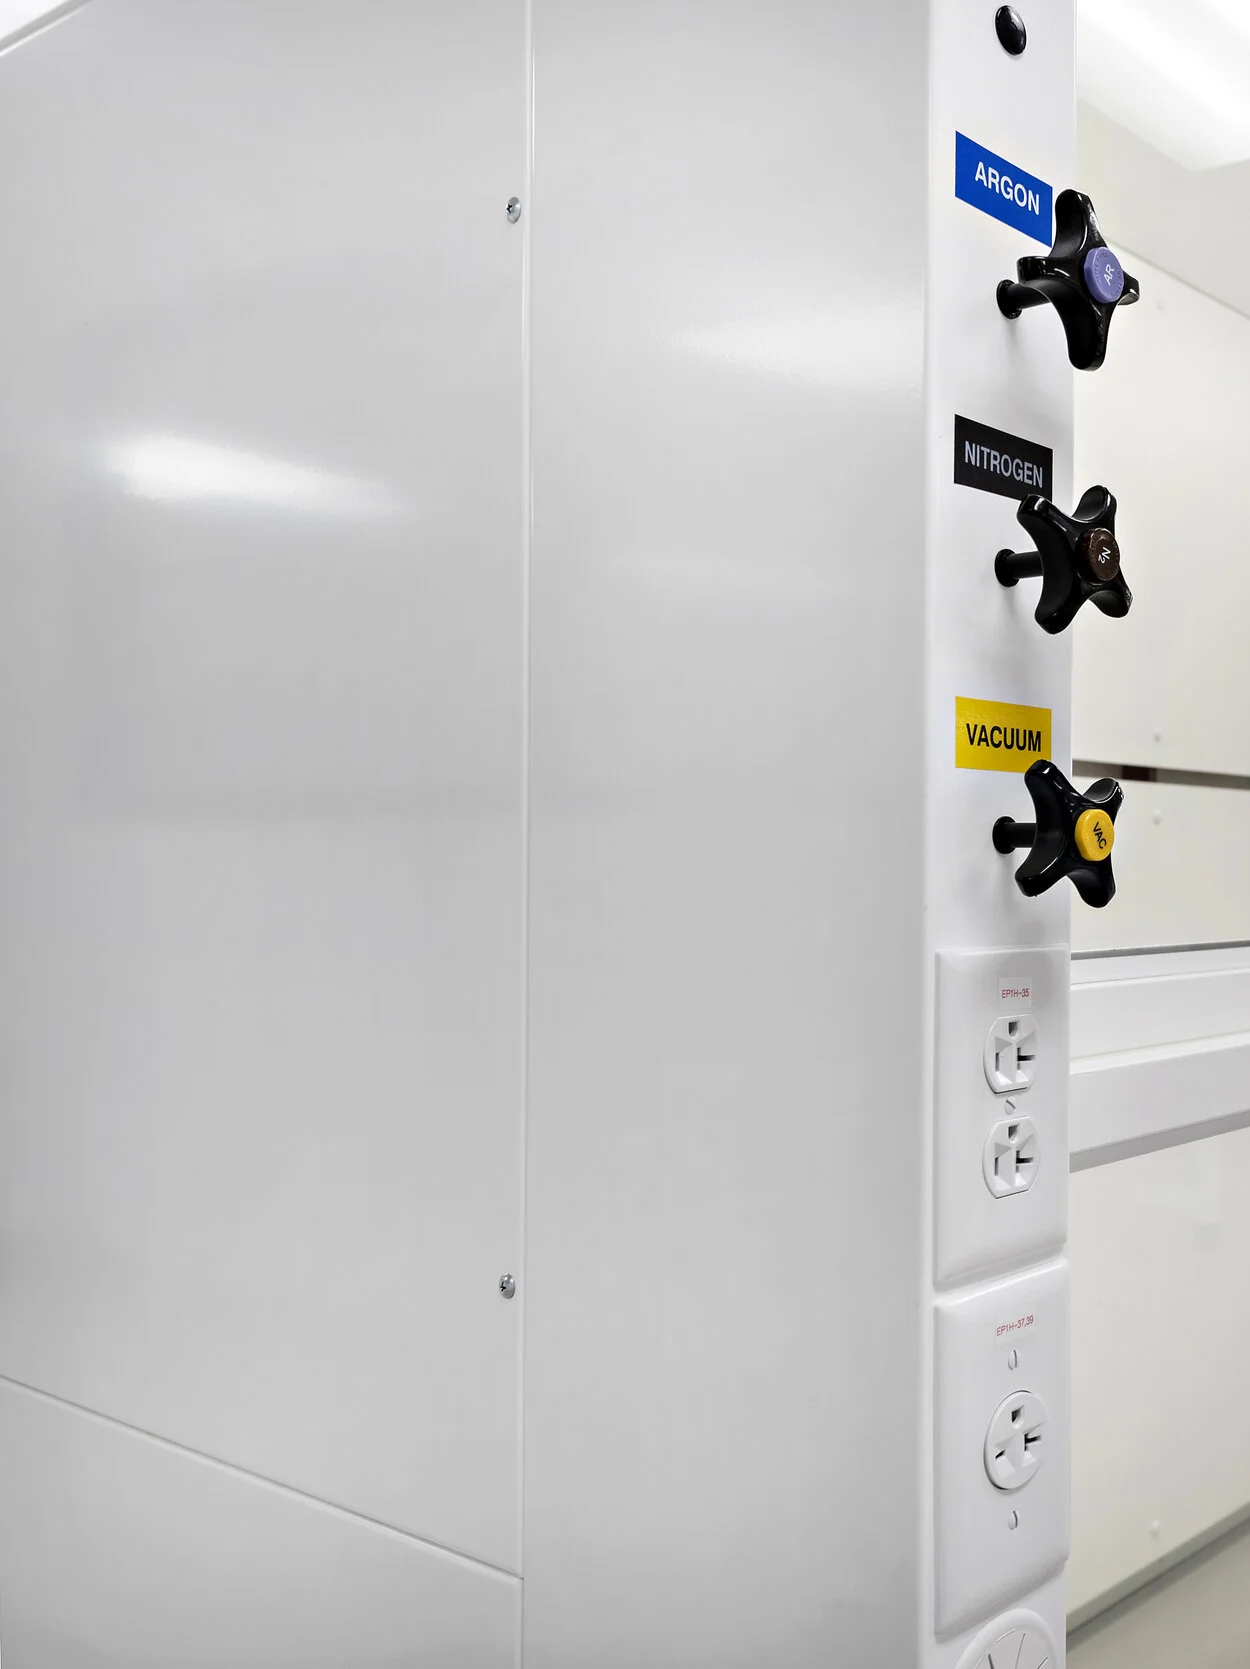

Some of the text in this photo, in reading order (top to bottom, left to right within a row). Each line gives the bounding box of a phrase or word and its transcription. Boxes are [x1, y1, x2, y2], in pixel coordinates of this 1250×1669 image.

[974, 161, 1040, 216] ARGON
[1103, 263, 1115, 287] AR
[964, 440, 1043, 488] NITROGEN
[966, 723, 1042, 752] VACUUM
[1092, 821, 1107, 849] VAC
[1001, 988, 1030, 999] EP1H-35
